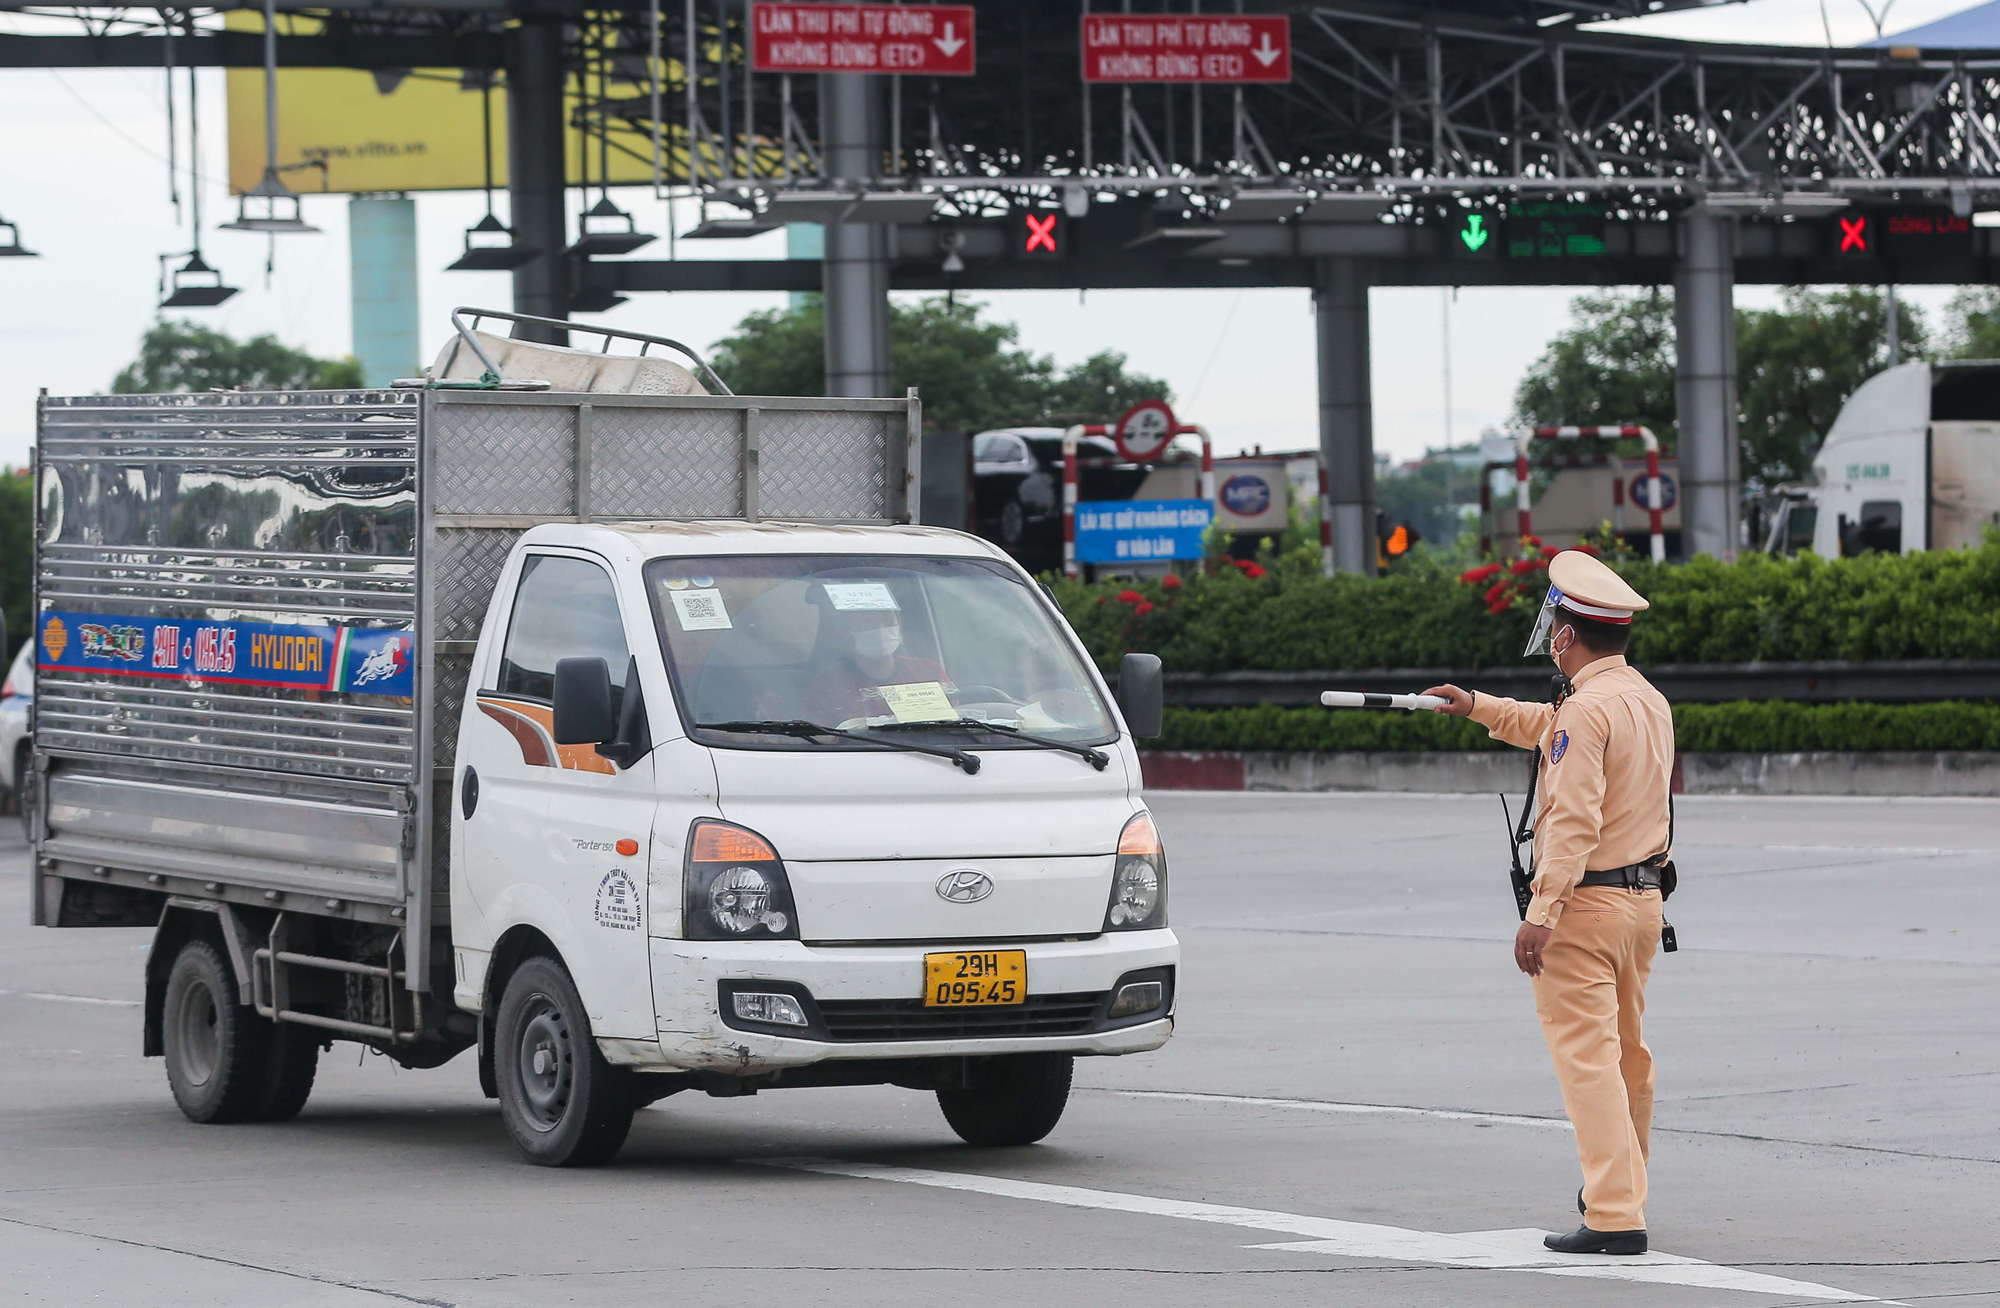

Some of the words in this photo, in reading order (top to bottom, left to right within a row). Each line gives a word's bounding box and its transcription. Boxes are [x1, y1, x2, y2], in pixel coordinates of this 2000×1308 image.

[796, 10, 829, 34] THU
[1123, 22, 1154, 46] THU
[880, 42, 925, 67] (ETC)
[251, 633, 323, 671] HYUNDAI
[577, 839, 601, 851] Porter
[955, 954, 997, 978] 29H
[936, 980, 1016, 1004] 095.45
